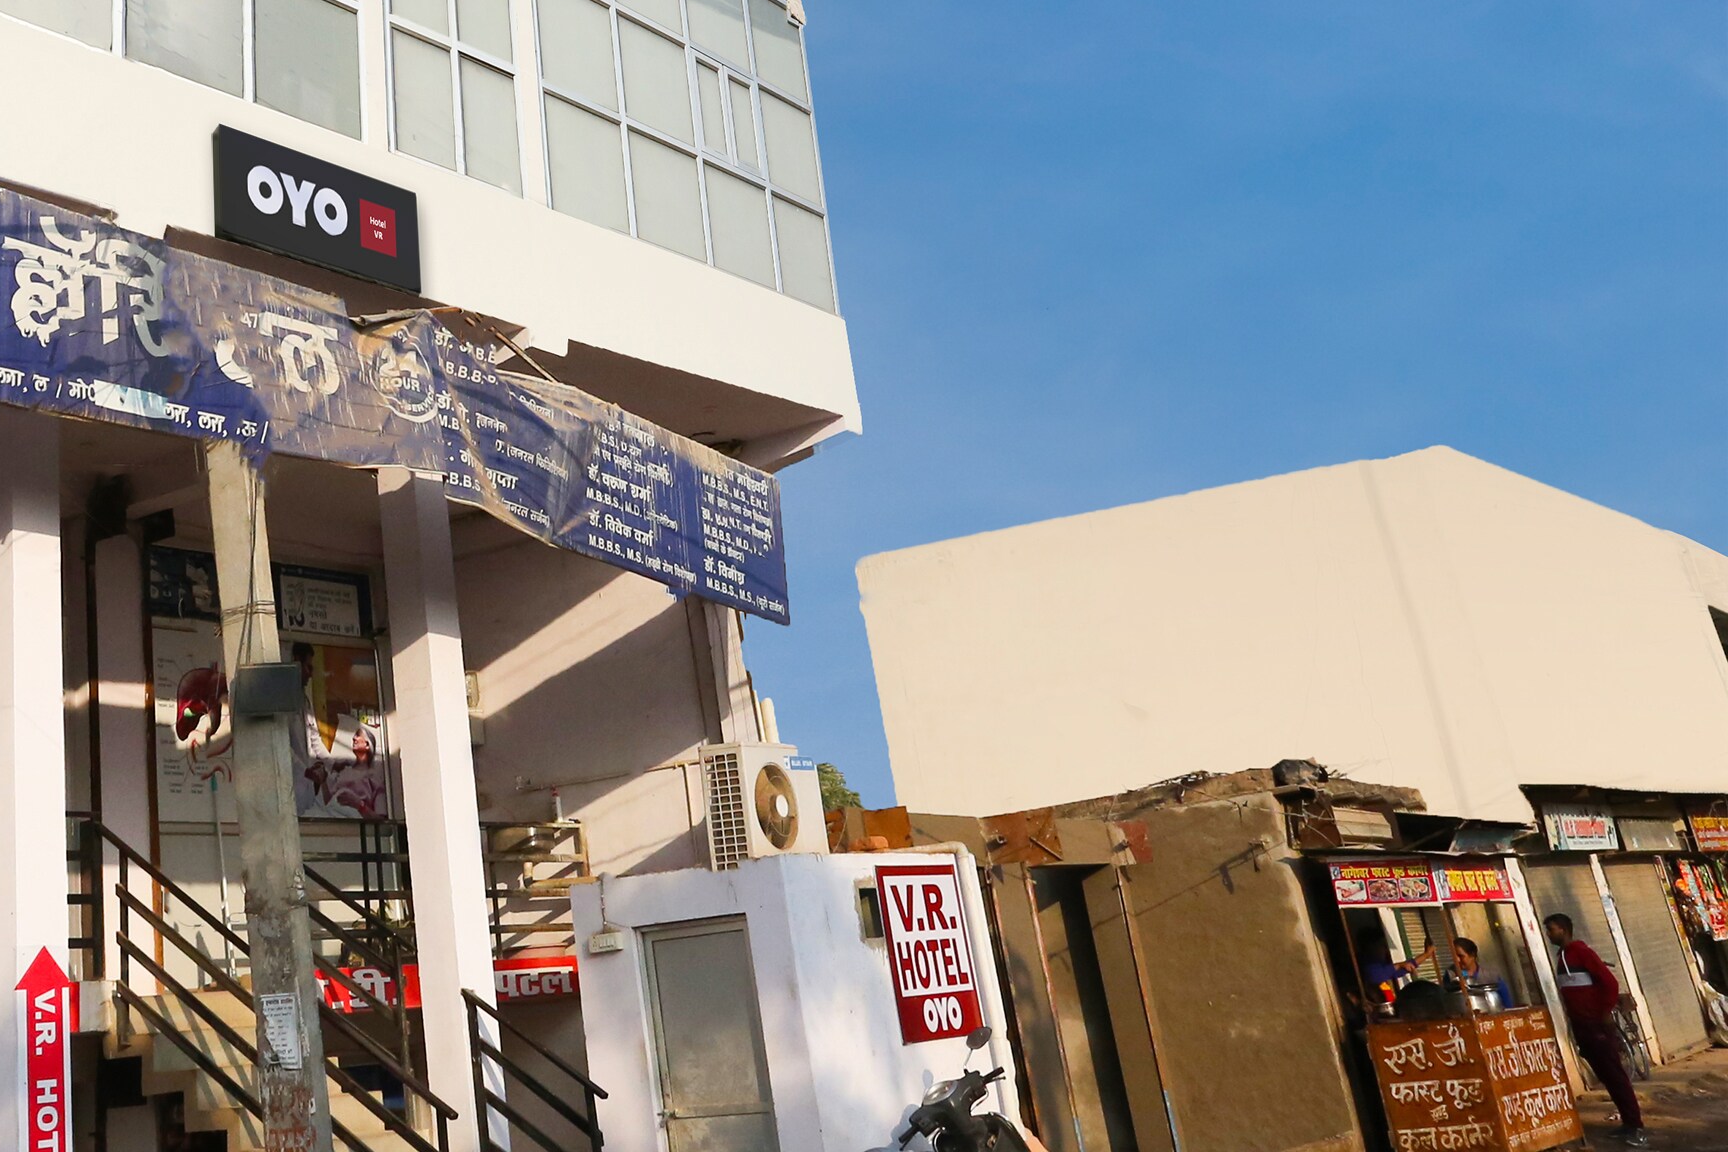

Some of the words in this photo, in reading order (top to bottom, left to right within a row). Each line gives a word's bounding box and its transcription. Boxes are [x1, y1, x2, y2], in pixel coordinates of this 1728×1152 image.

[247, 164, 348, 236] OYO
[369, 216, 387, 229] Hotel
[373, 229, 384, 240] VR
[889, 883, 957, 932] V.R.
[897, 938, 969, 991] HOTEL
[34, 987, 57, 1056] V.R.
[923, 996, 963, 1033] OYO
